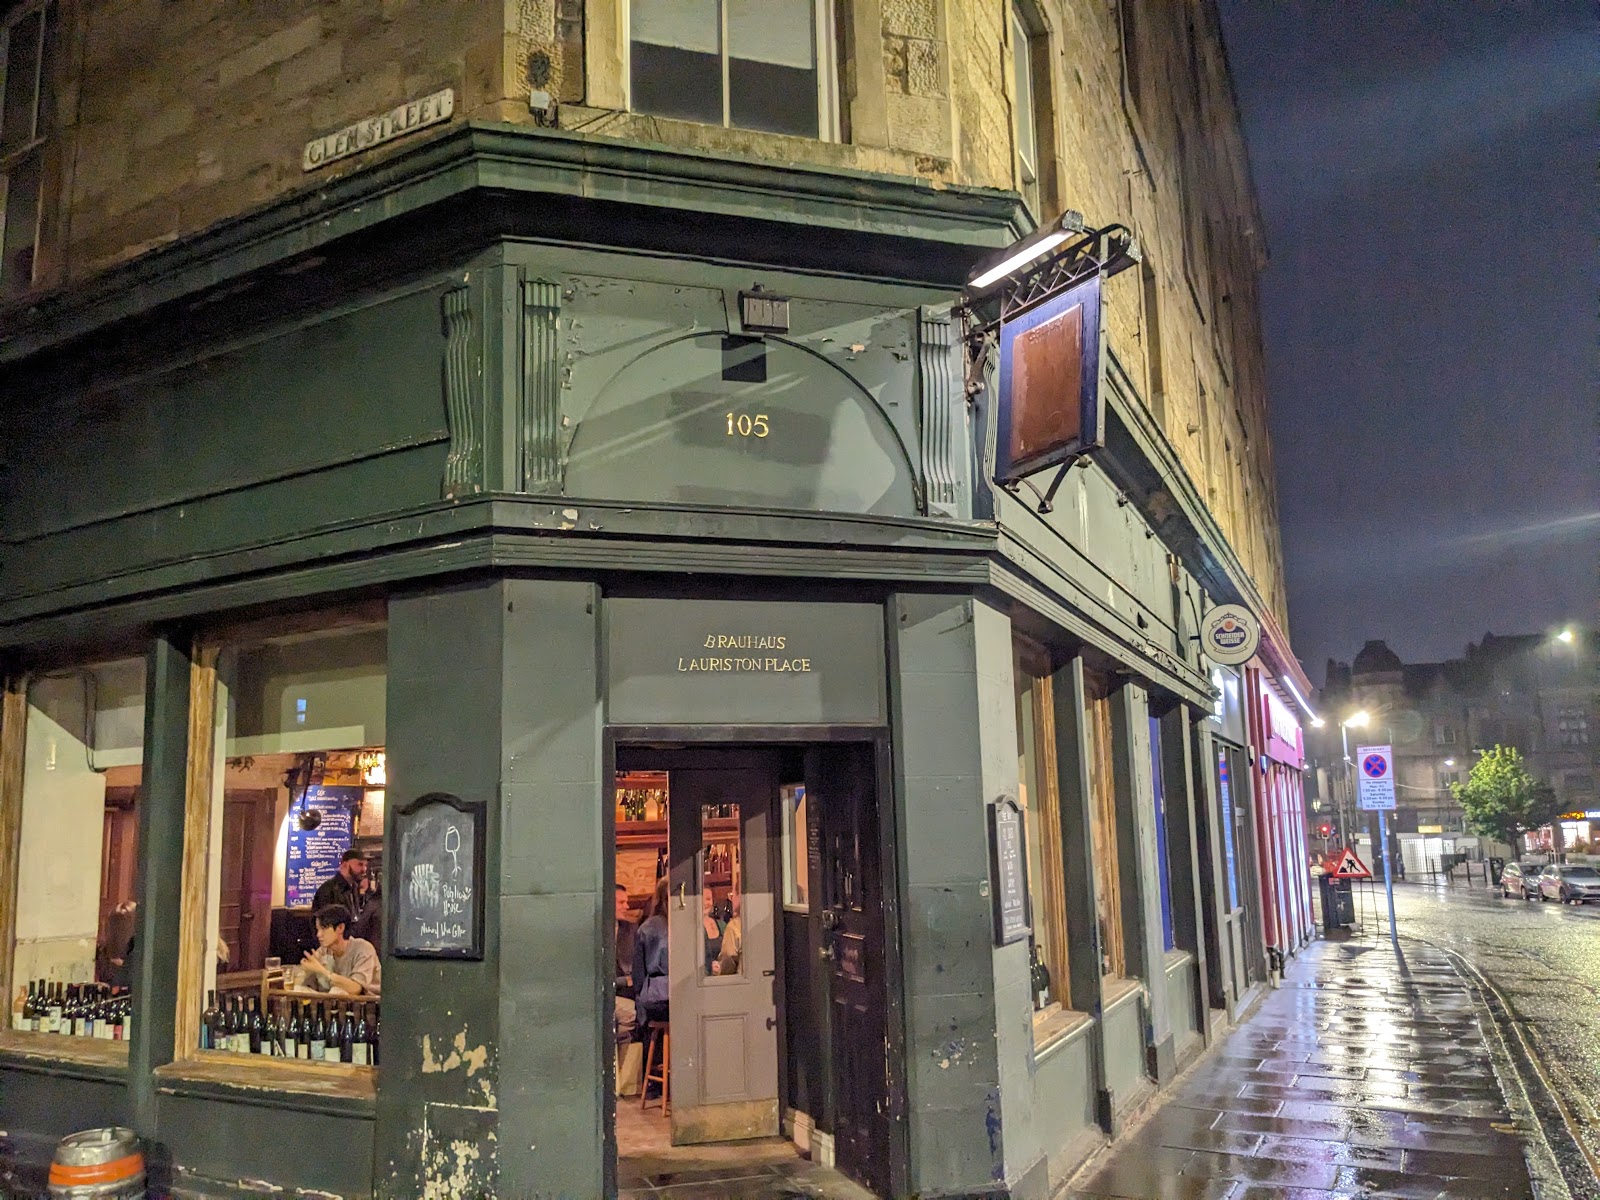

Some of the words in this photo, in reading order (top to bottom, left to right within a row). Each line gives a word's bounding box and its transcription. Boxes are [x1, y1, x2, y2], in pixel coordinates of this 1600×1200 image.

[366, 92, 448, 144] STREET
[725, 412, 770, 438] 105
[704, 634, 786, 650] BRAUHAUS
[677, 657, 762, 672] LAURISTON
[764, 658, 811, 672] PLACE
